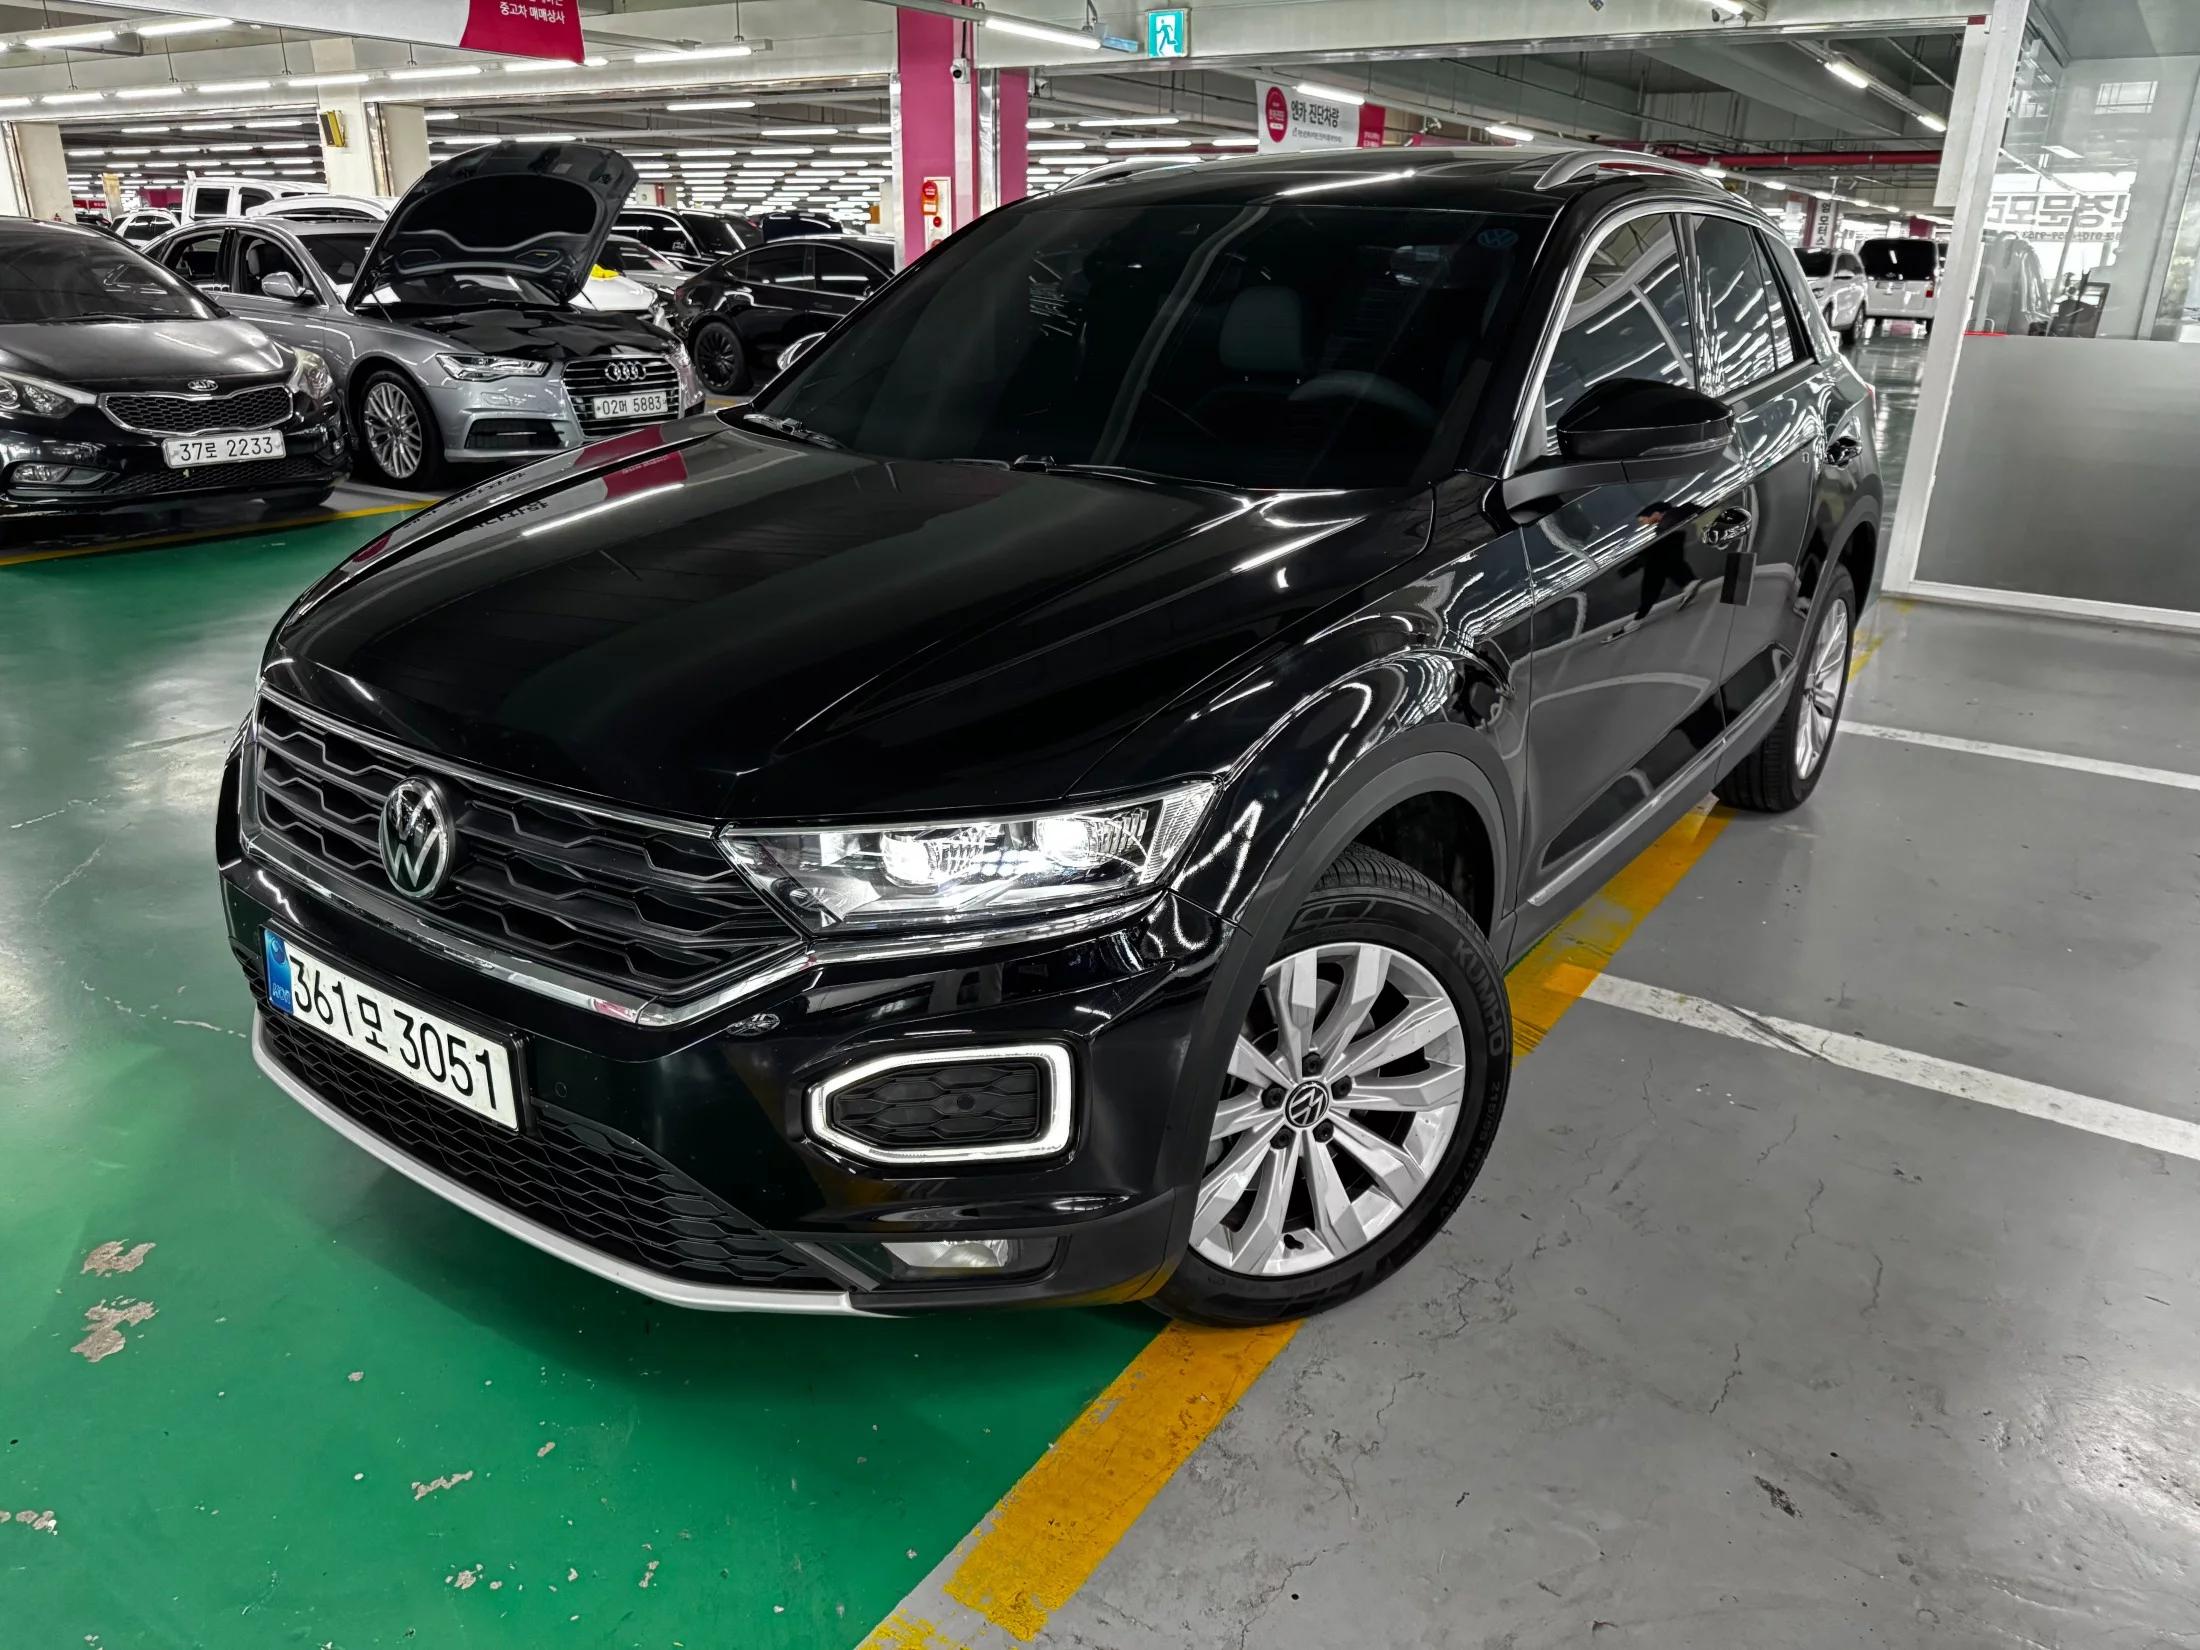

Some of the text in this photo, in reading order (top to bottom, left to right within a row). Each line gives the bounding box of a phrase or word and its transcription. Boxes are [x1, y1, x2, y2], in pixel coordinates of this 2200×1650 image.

[499, 1, 565, 24] 중고차 매매상사
[633, 396, 662, 412] 5883
[179, 436, 273, 461] 37로 2233
[1453, 938, 1505, 1057] KUMHO
[289, 954, 497, 1111] 361모 3051
